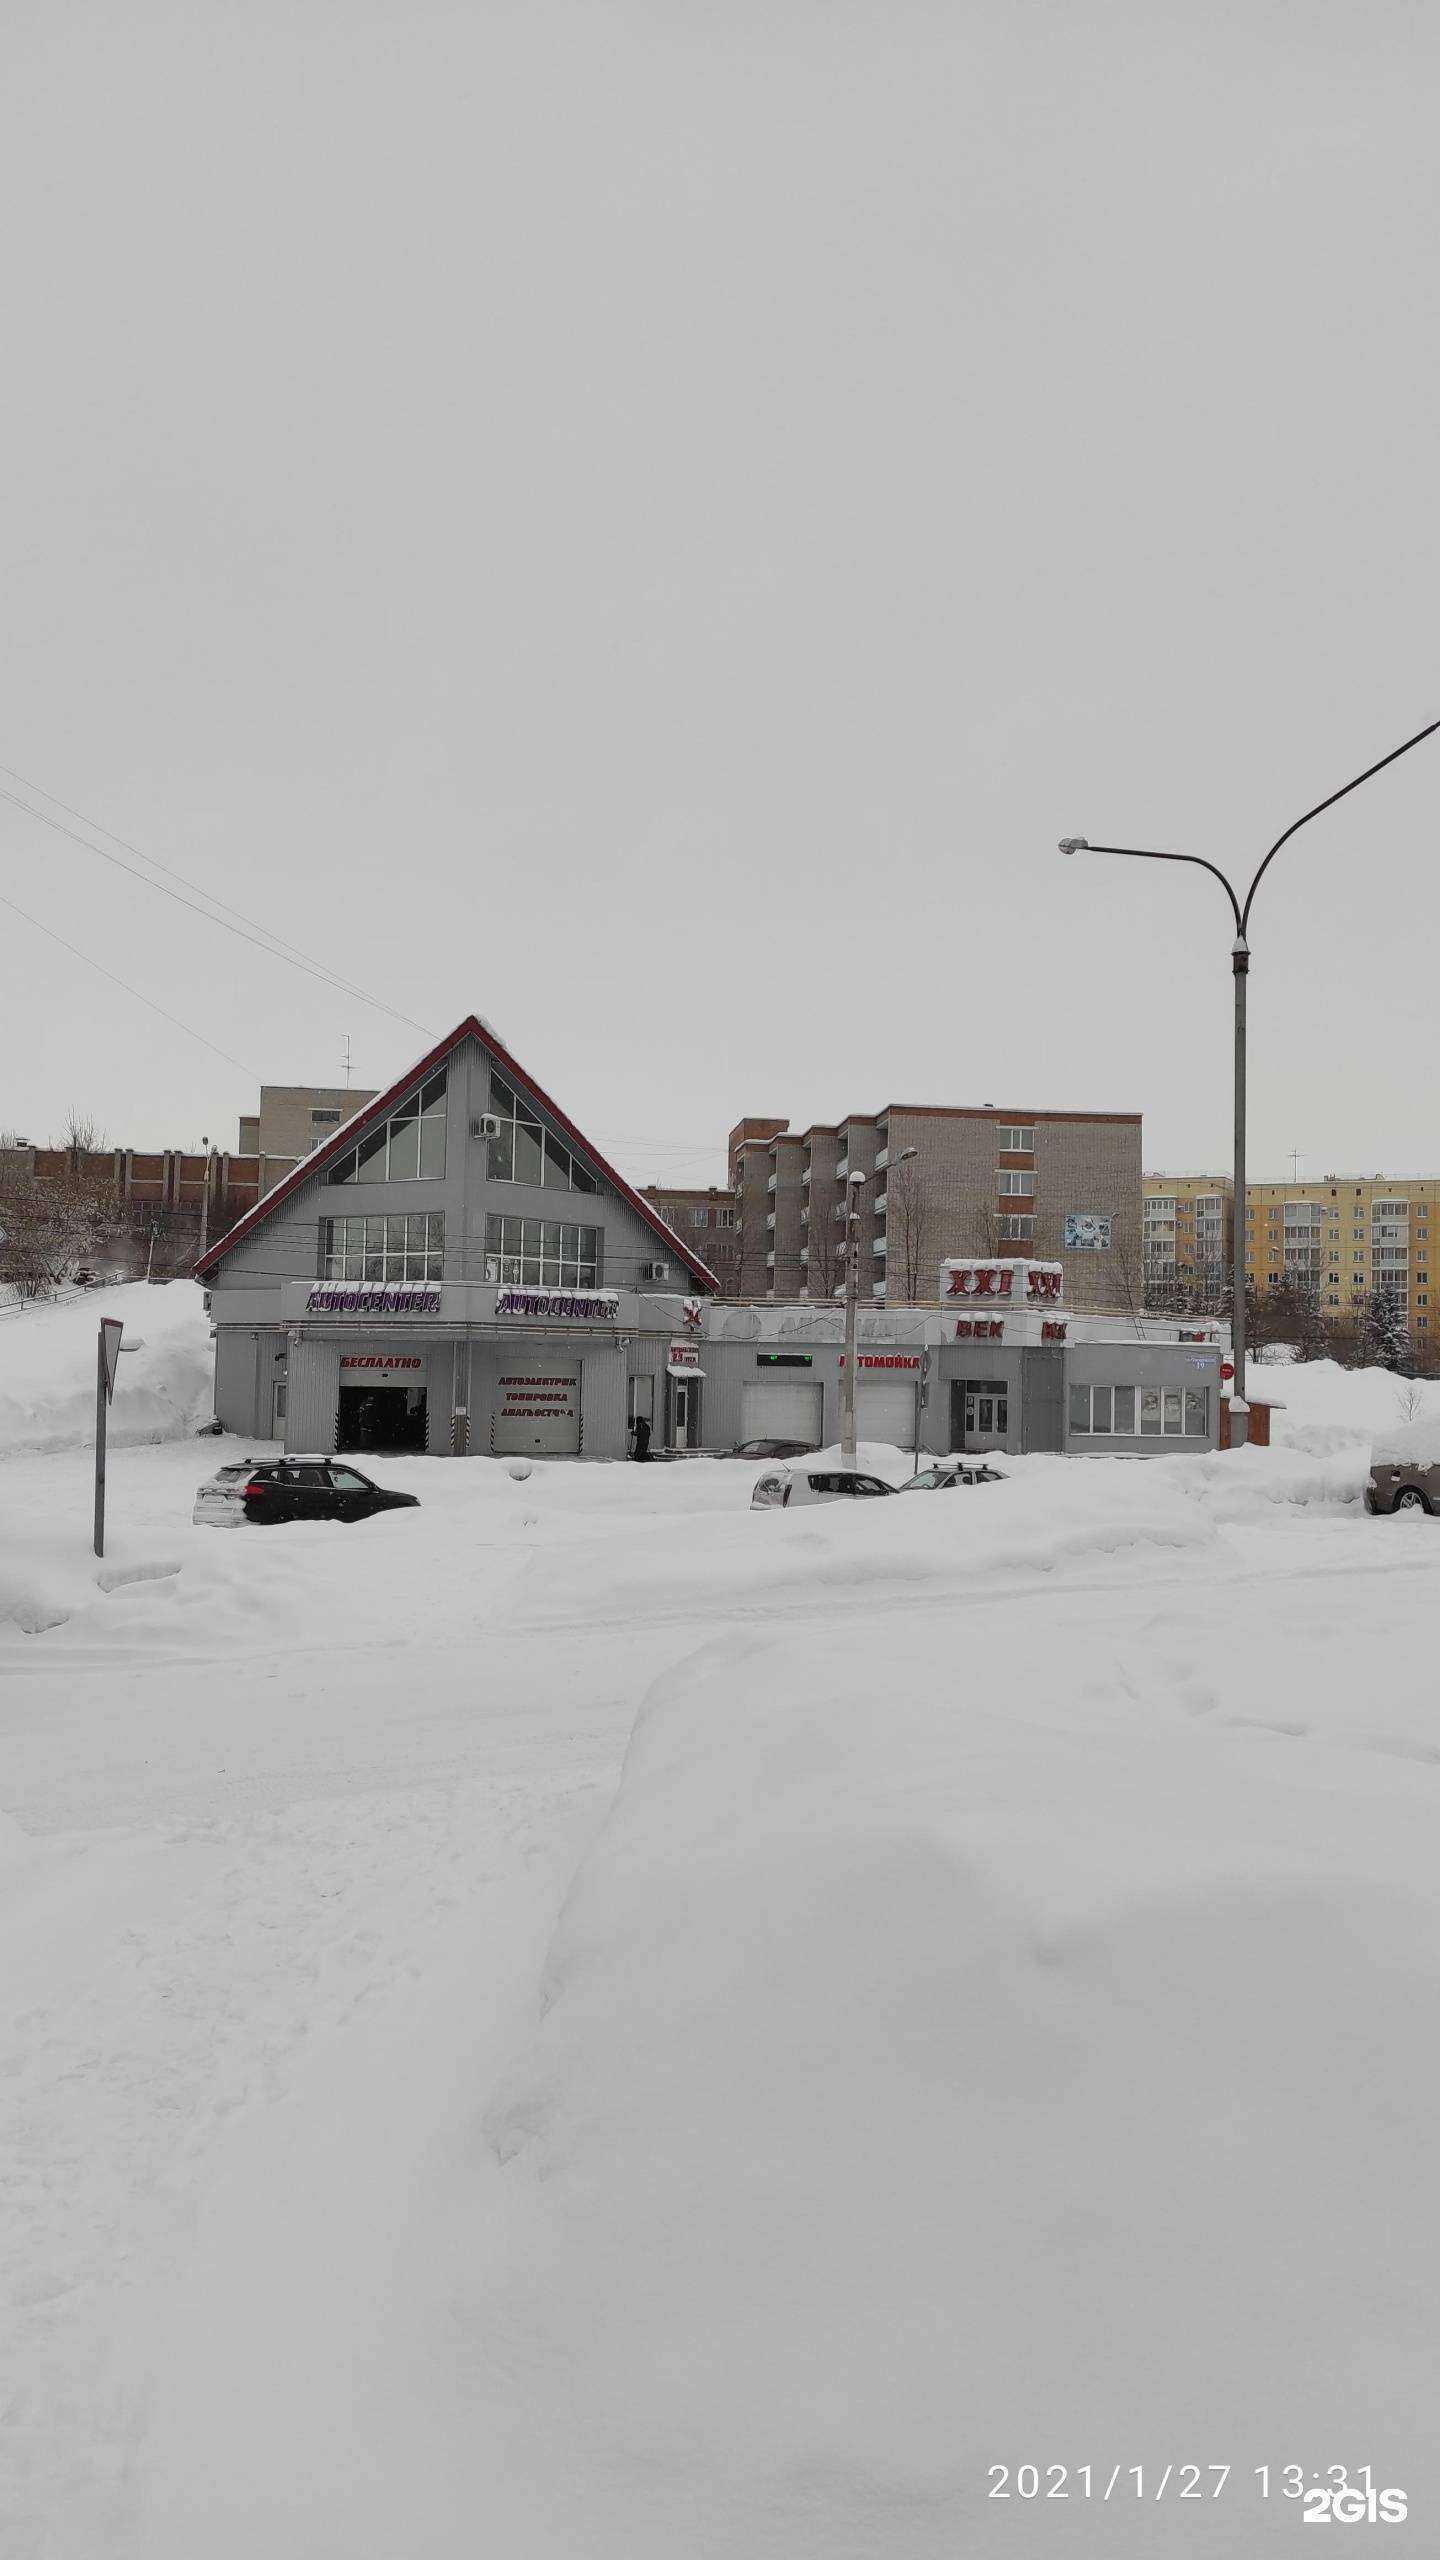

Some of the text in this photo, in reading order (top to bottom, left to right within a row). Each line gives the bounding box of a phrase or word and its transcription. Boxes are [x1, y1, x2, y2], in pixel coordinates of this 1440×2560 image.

[946, 1269, 1014, 1295] XXI
[305, 1290, 441, 1312] AUTOCENTER
[495, 1294, 619, 1319] AUTOCENTER
[955, 1320, 1005, 1338] ВЕК
[340, 1356, 421, 1369] БЕСПЛАТНО
[837, 1354, 920, 1369] АТОМОЙКА
